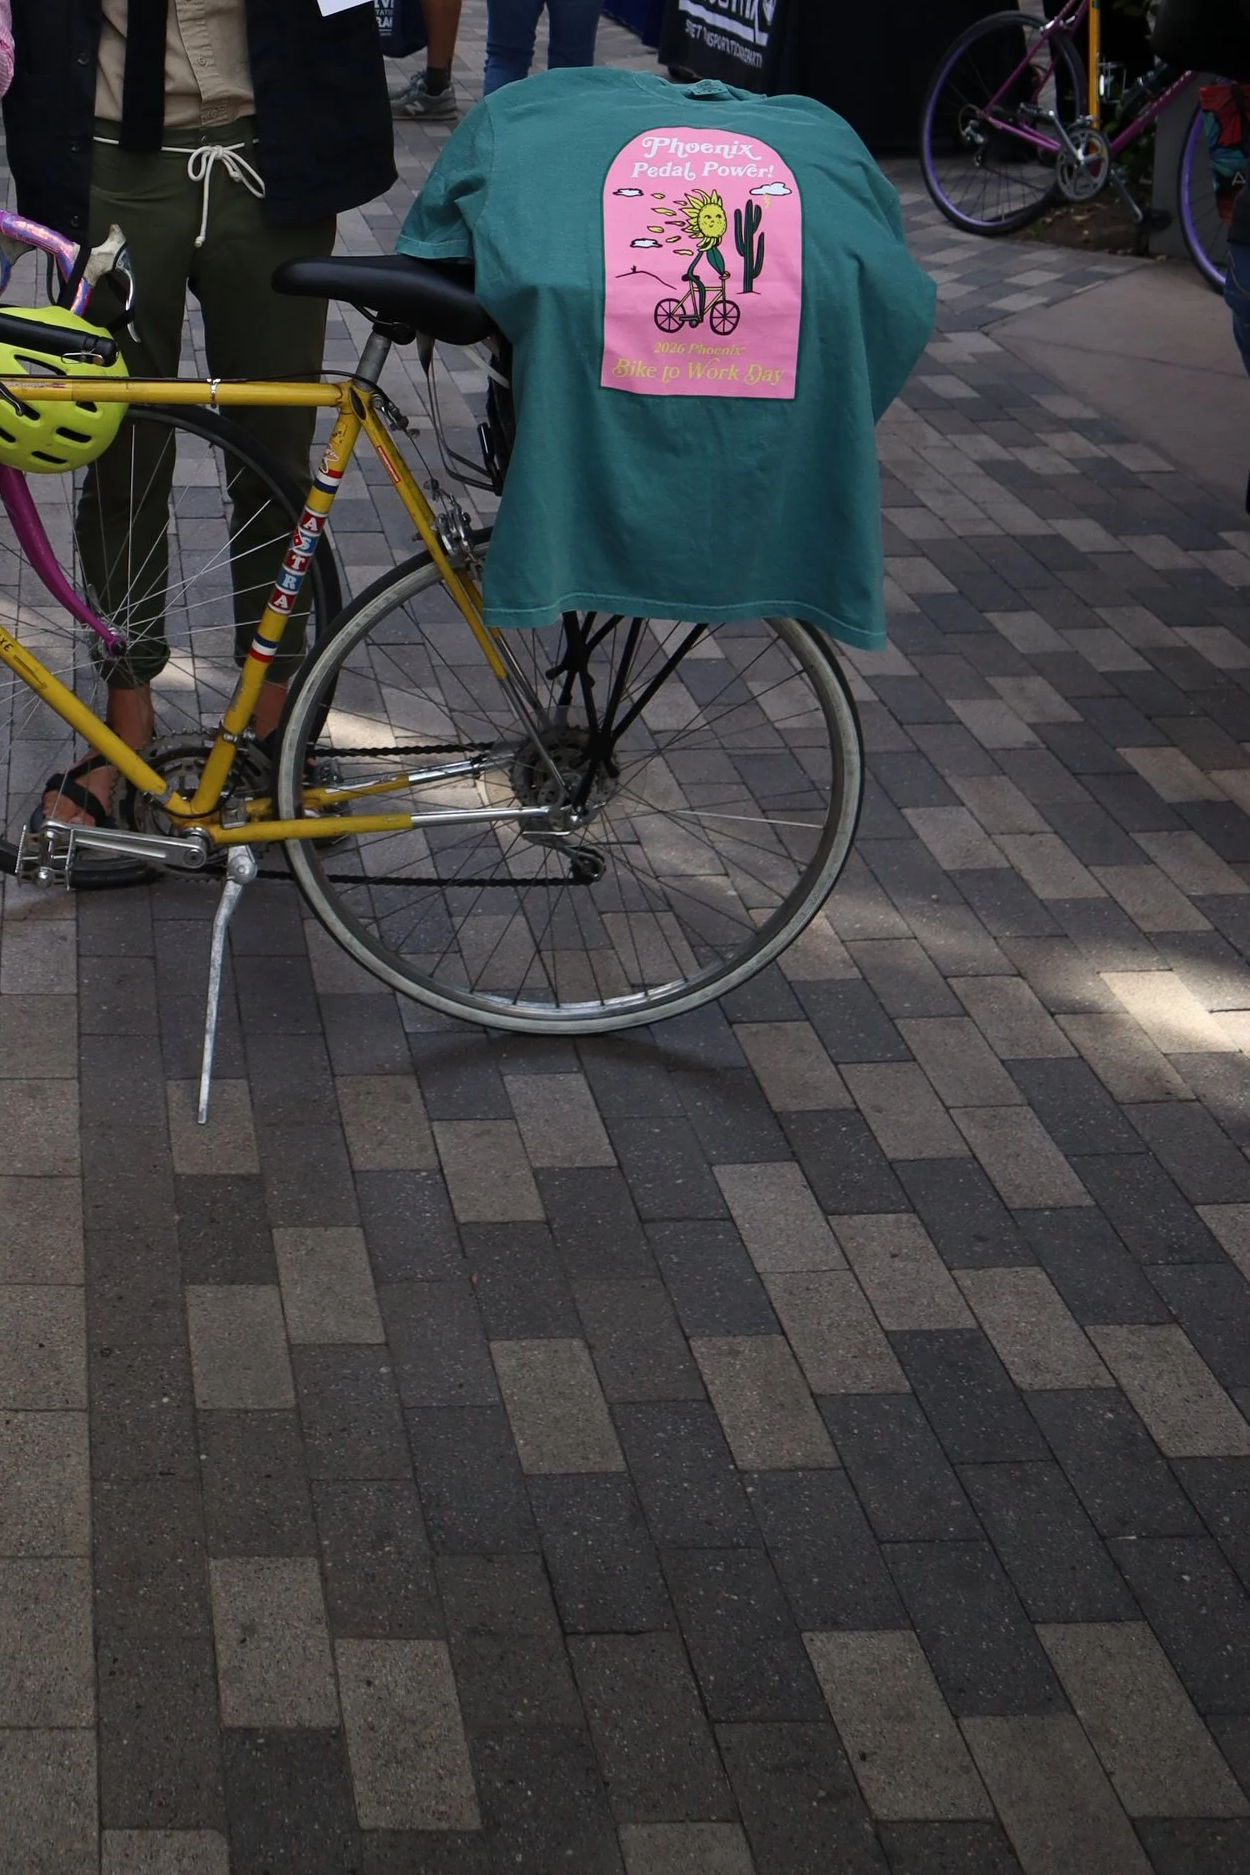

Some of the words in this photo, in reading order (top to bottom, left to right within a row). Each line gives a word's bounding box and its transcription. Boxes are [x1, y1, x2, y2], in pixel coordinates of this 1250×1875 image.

[641, 136, 762, 161] Phoenix
[631, 161, 696, 181] Pedal
[701, 161, 775, 178] Power!
[653, 341, 686, 355] 2026
[688, 342, 746, 356] Phoenix
[612, 358, 657, 378] Bike
[661, 363, 681, 385] to
[687, 357, 739, 381] Work
[743, 364, 784, 386] Day
[274, 516, 318, 609] ASTRA
